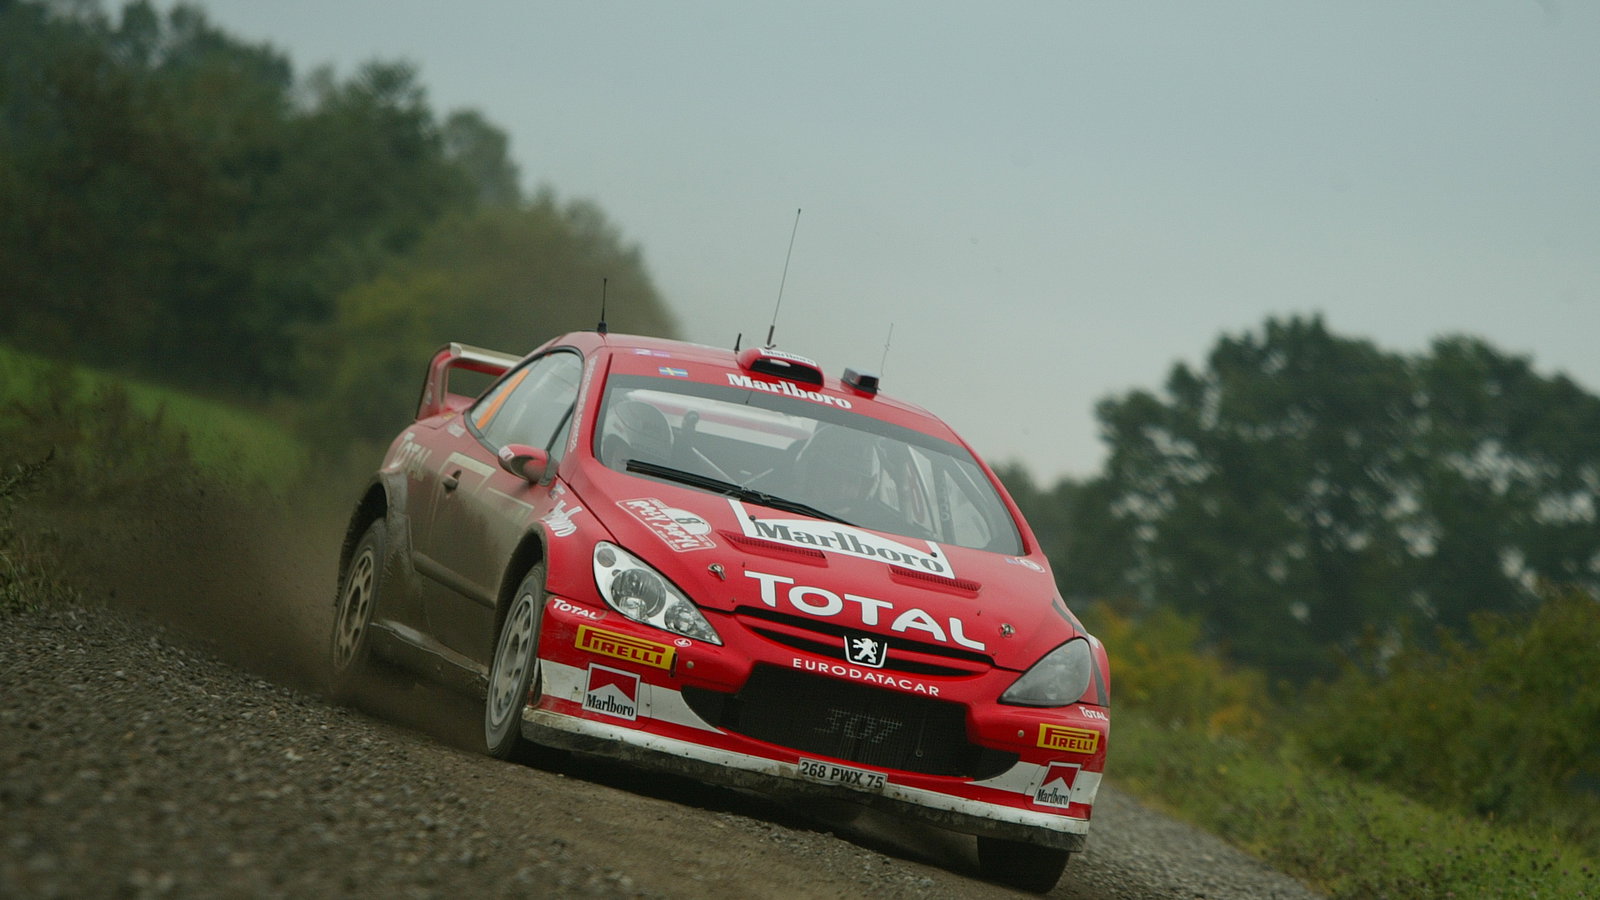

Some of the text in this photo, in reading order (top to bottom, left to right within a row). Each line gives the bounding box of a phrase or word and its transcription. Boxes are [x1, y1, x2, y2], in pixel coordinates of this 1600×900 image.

[726, 373, 852, 410] Marlboro
[754, 519, 944, 573] Marlboro
[553, 598, 598, 620] TOTAL
[745, 570, 985, 652] TOTAL
[583, 629, 666, 665] PIRELLI
[793, 658, 940, 696] EURODATACAR
[586, 694, 635, 717] Marlboro
[1078, 706, 1109, 721] TOTAL
[1043, 727, 1095, 751] PIRELLI
[801, 762, 884, 790] 268 PWX 75
[1036, 788, 1069, 805] Marlboro
